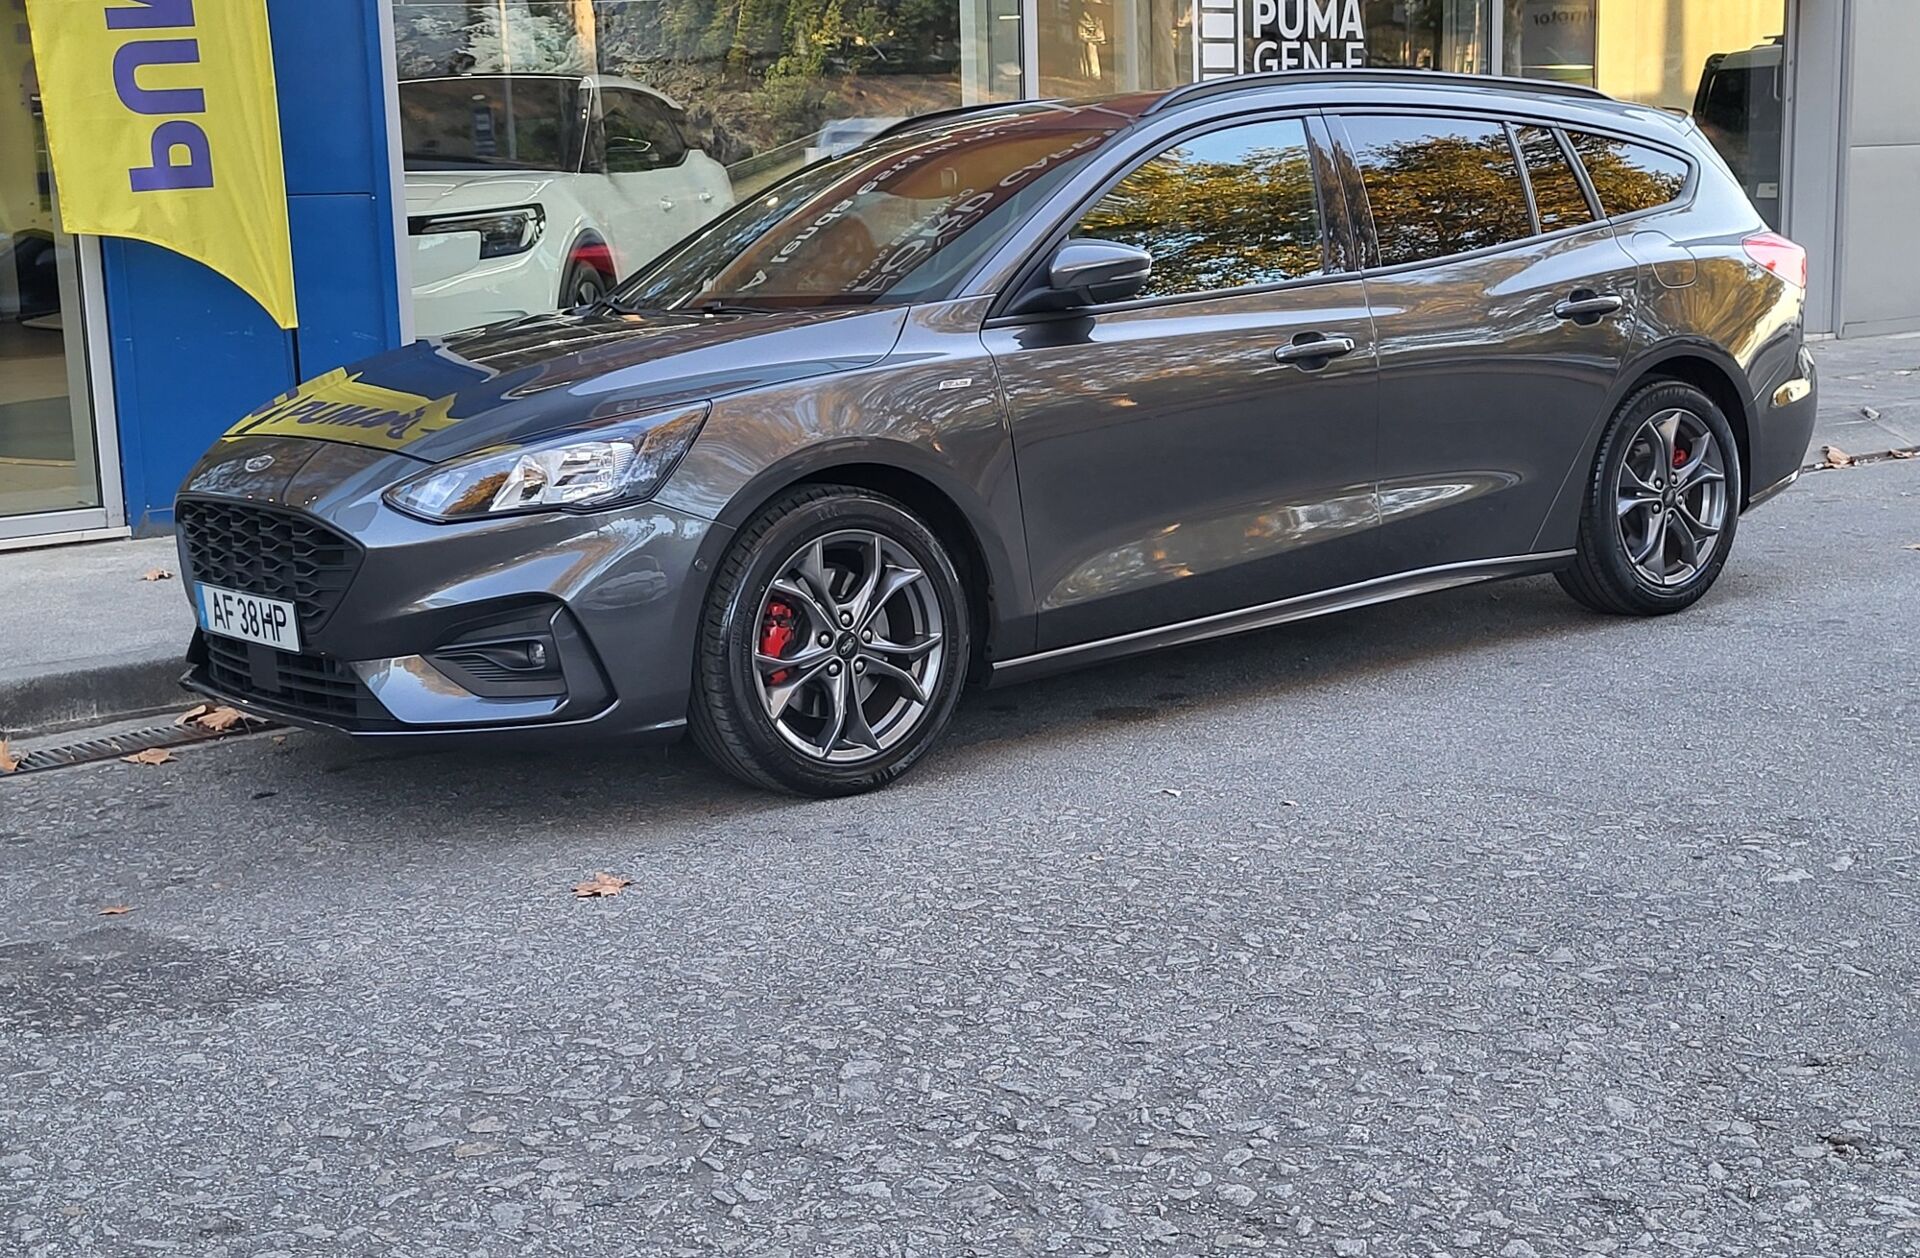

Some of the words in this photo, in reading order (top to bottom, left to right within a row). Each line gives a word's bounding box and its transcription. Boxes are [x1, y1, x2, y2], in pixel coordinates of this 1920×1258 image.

[1253, 0, 1364, 39] PUMA
[1254, 40, 1364, 72] GEN-E
[213, 591, 234, 630] AF
